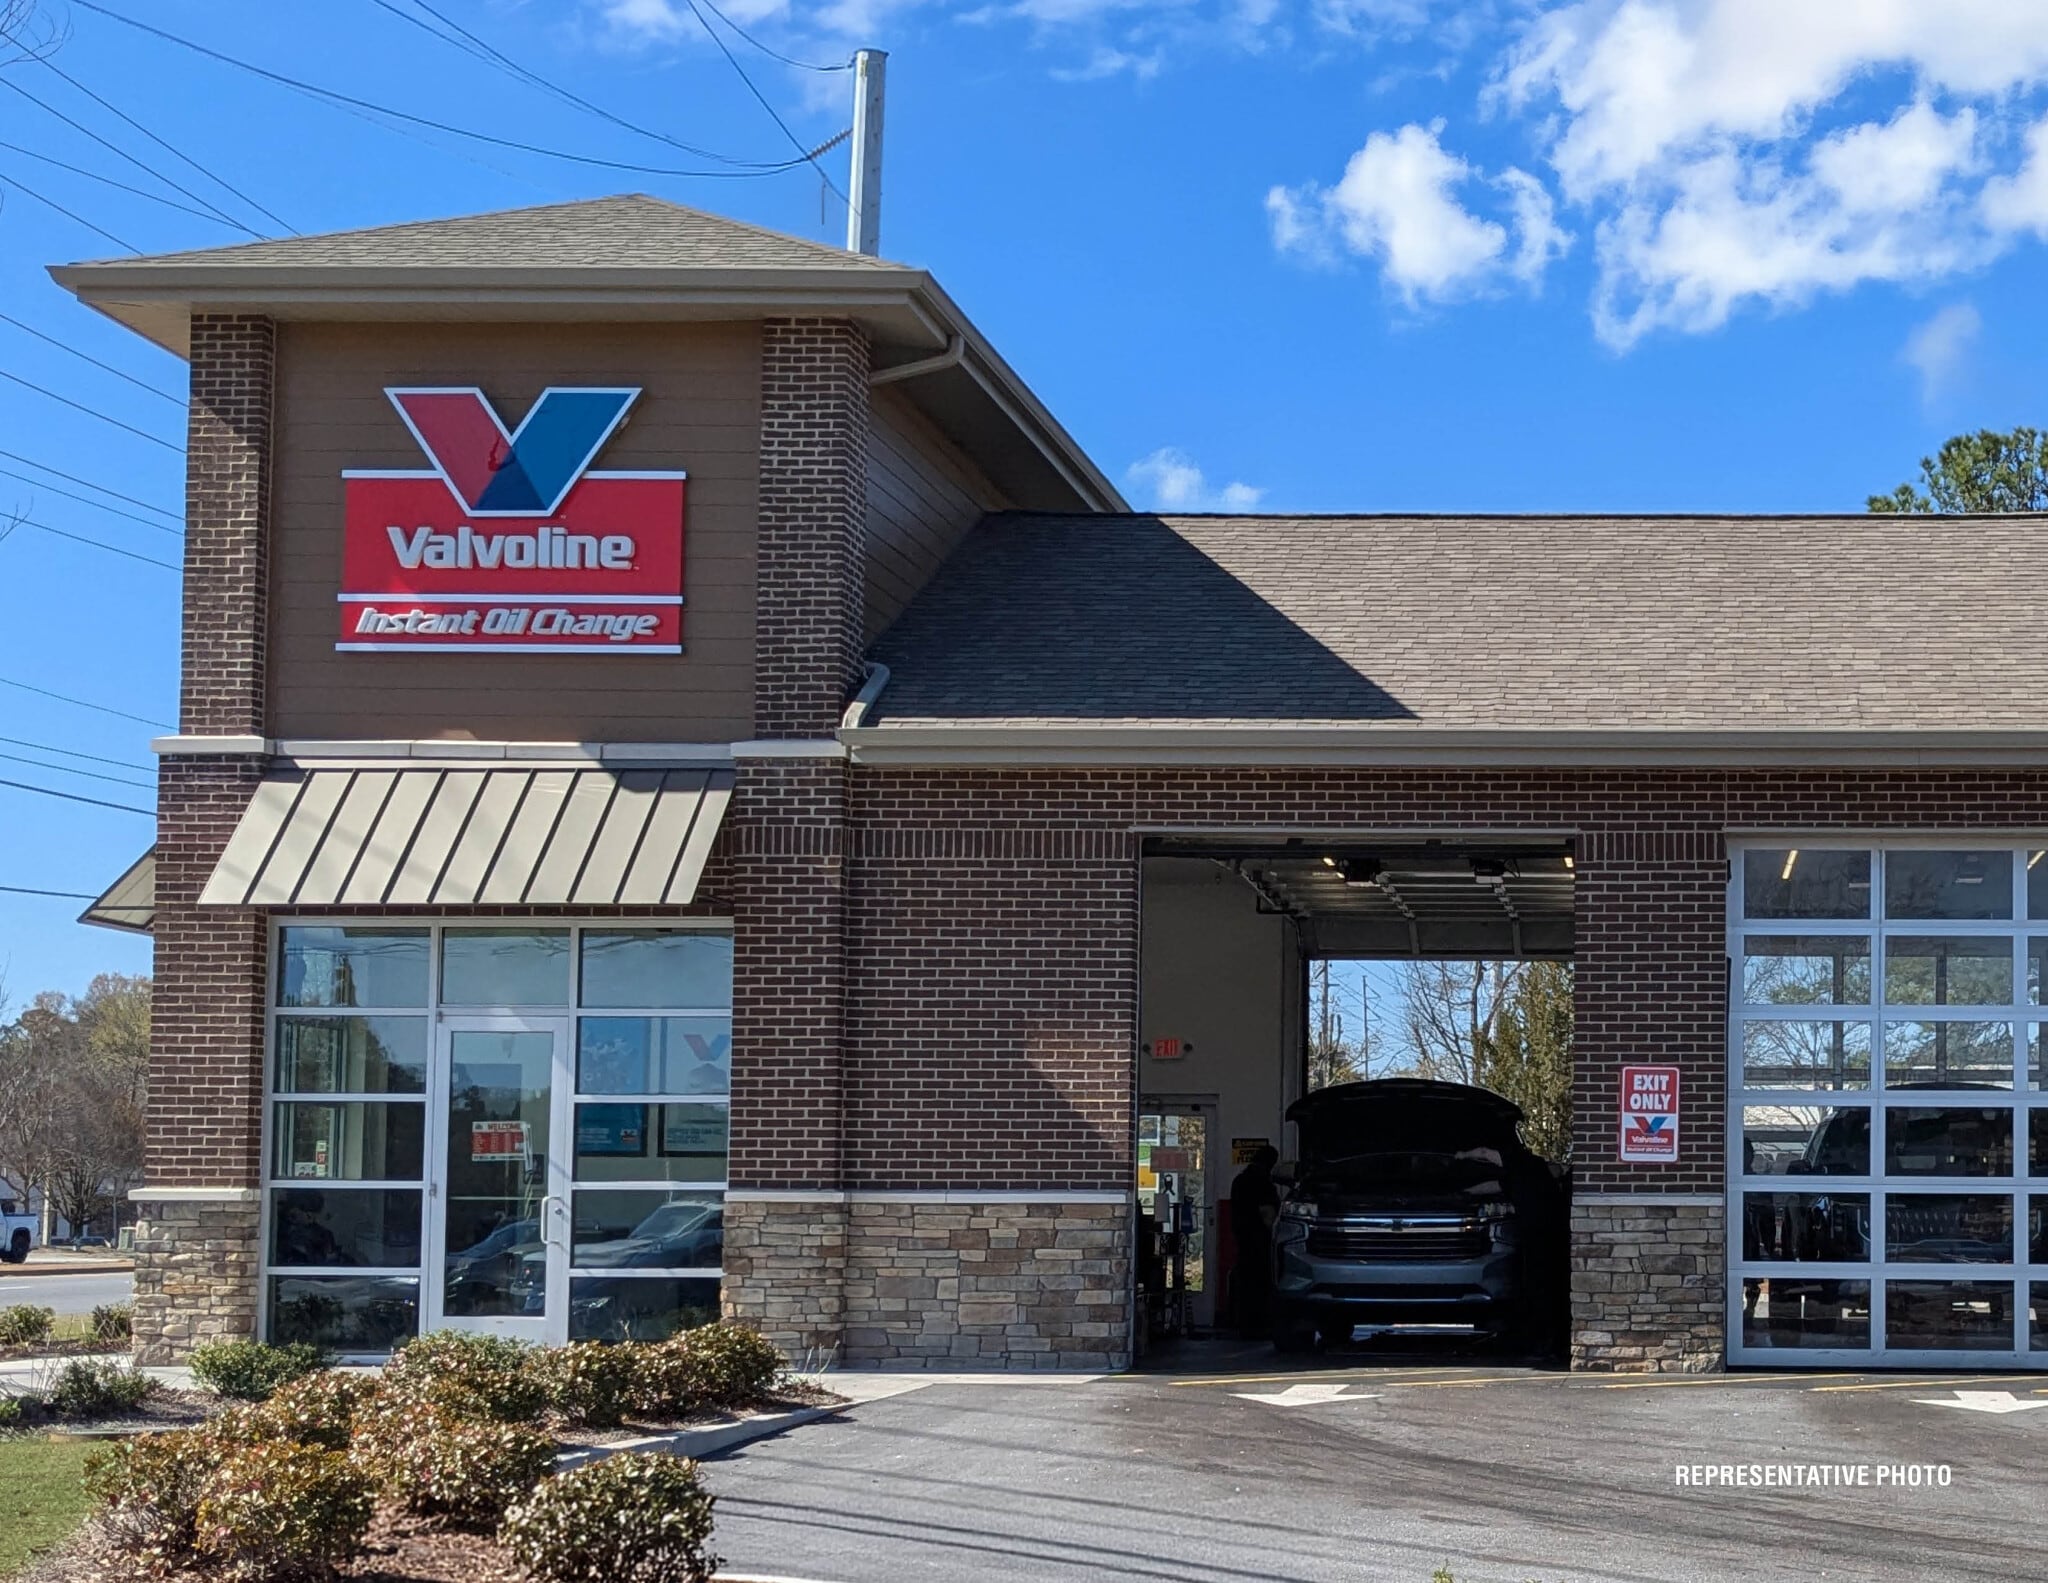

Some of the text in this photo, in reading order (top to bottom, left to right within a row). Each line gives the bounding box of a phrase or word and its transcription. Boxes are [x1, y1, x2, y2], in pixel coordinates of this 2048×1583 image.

[386, 526, 635, 569] Valvoline
[354, 607, 660, 640] Instant Oil Change
[1633, 1074, 1670, 1091] EXIT
[1629, 1093, 1671, 1110] ONLY
